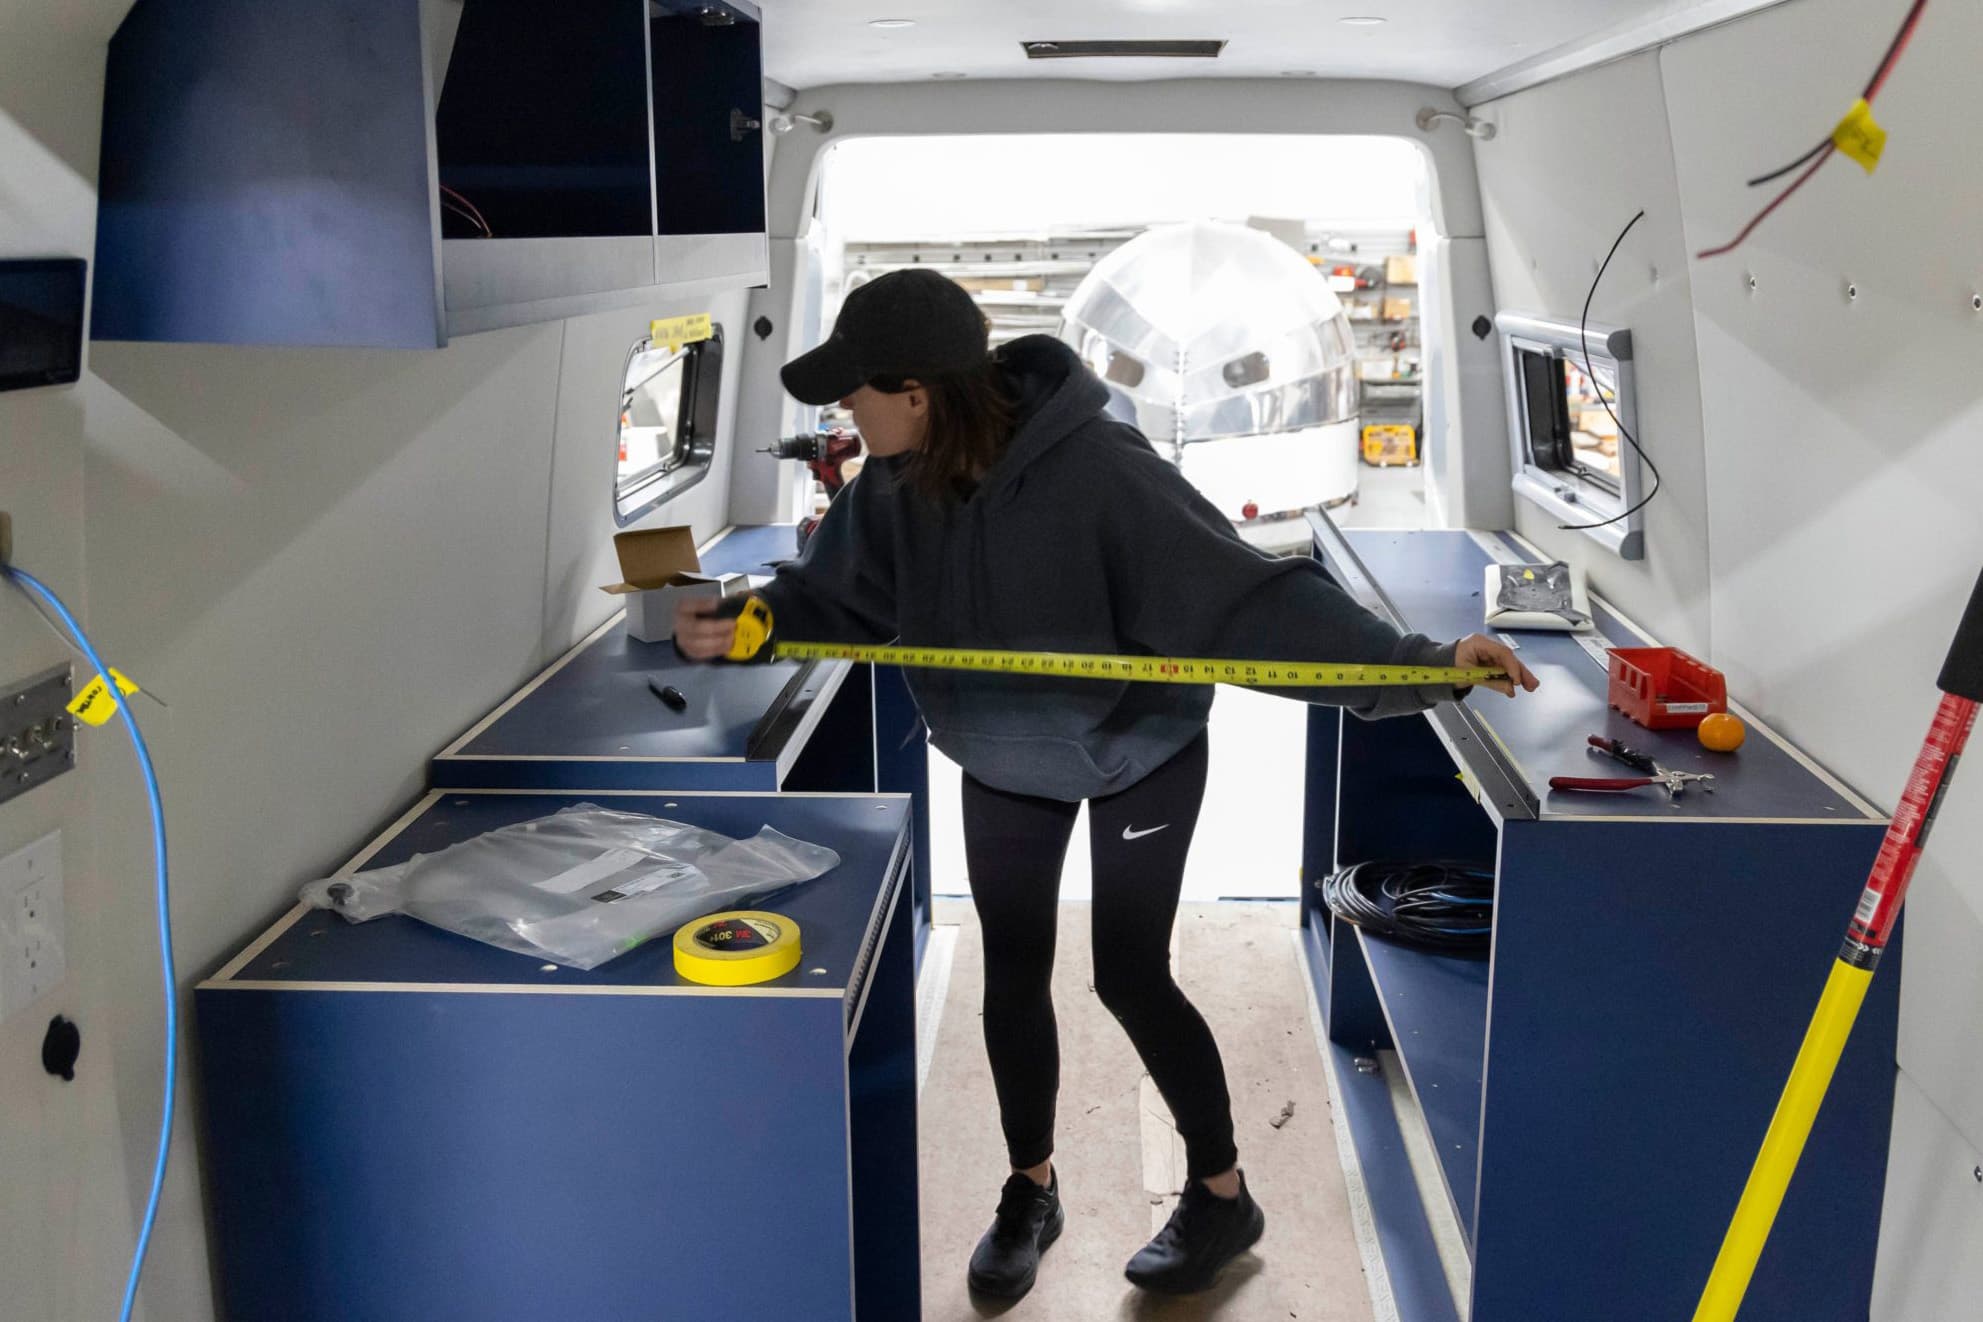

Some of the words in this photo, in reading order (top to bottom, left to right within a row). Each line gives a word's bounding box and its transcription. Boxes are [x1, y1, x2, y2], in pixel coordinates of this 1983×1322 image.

[1142, 663, 1152, 672] 17
[1184, 665, 1193, 673] 15
[1204, 665, 1214, 673] 14
[1225, 666, 1235, 674] 13
[1246, 667, 1256, 675] 12
[1269, 670, 1276, 678] 11
[736, 929, 751, 939] 3M
